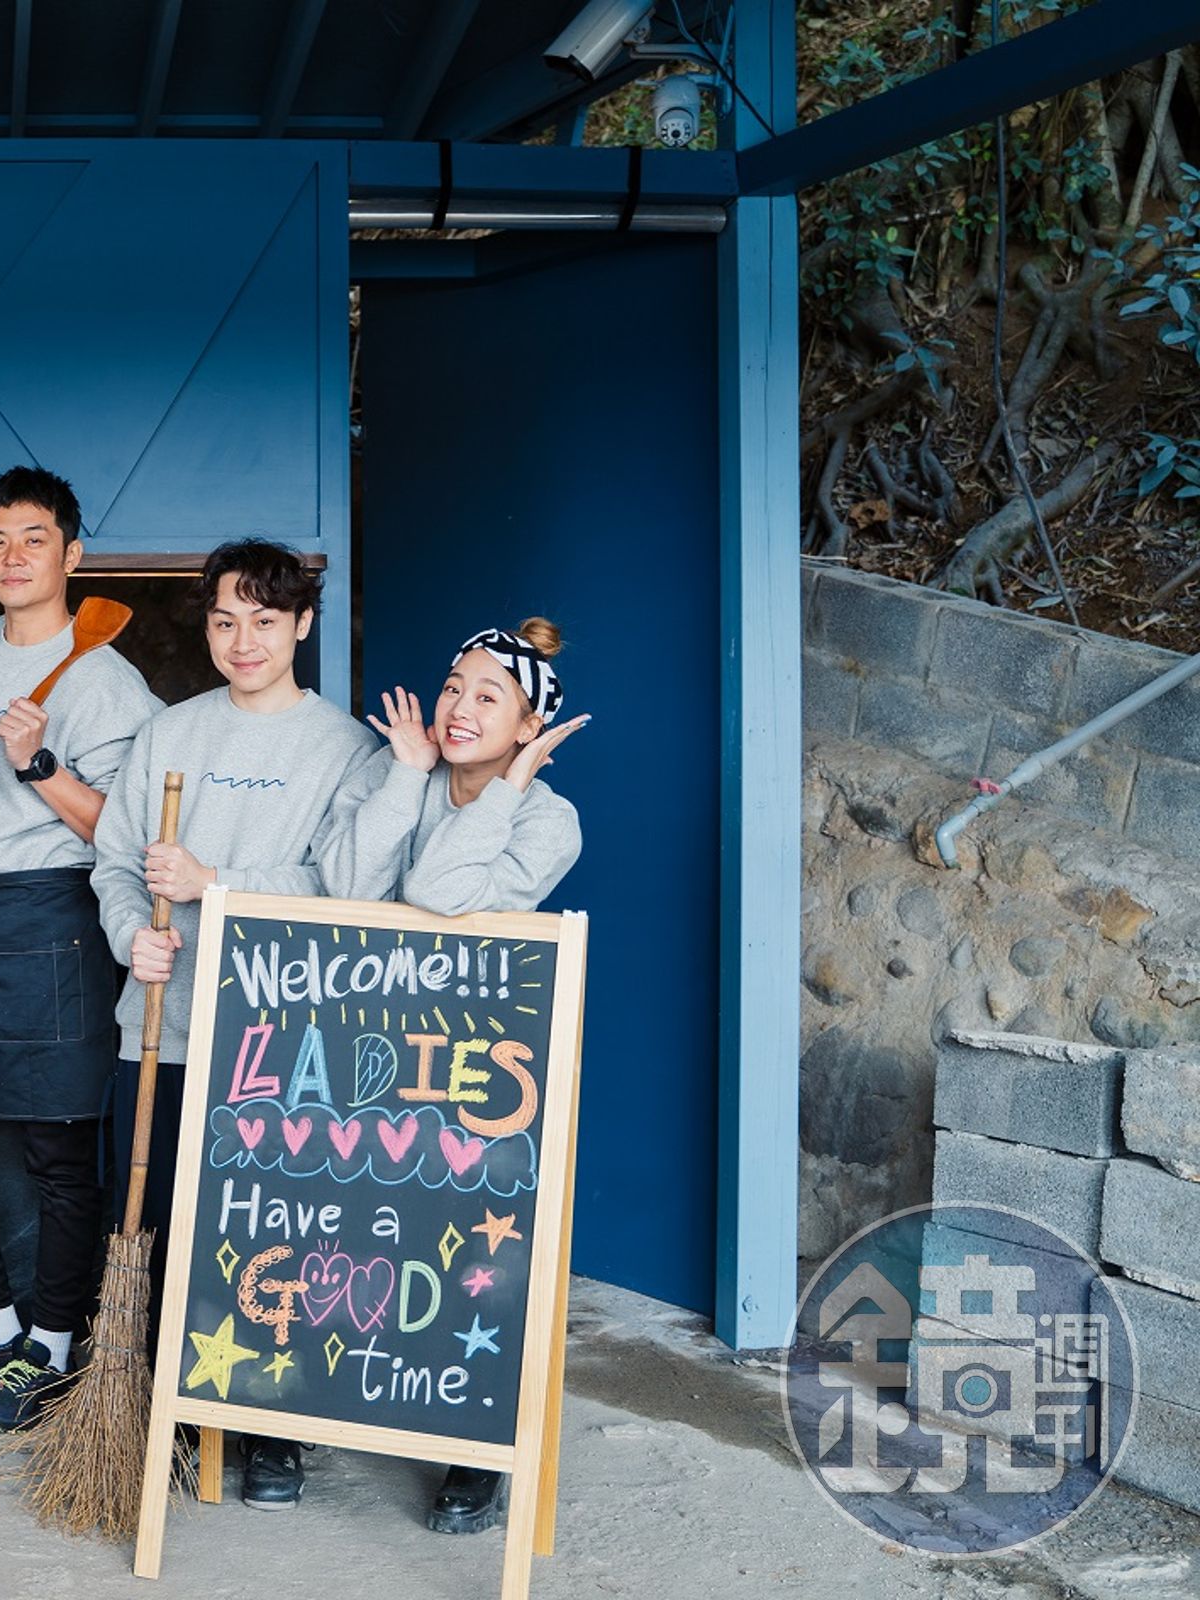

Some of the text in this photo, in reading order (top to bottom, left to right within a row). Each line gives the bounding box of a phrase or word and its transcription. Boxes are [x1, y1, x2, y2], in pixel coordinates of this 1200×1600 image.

[232, 939, 511, 1008] Welcome!!!
[226, 1023, 539, 1138] LADIES
[218, 1178, 401, 1244] Have a
[347, 1335, 494, 1406] time.
